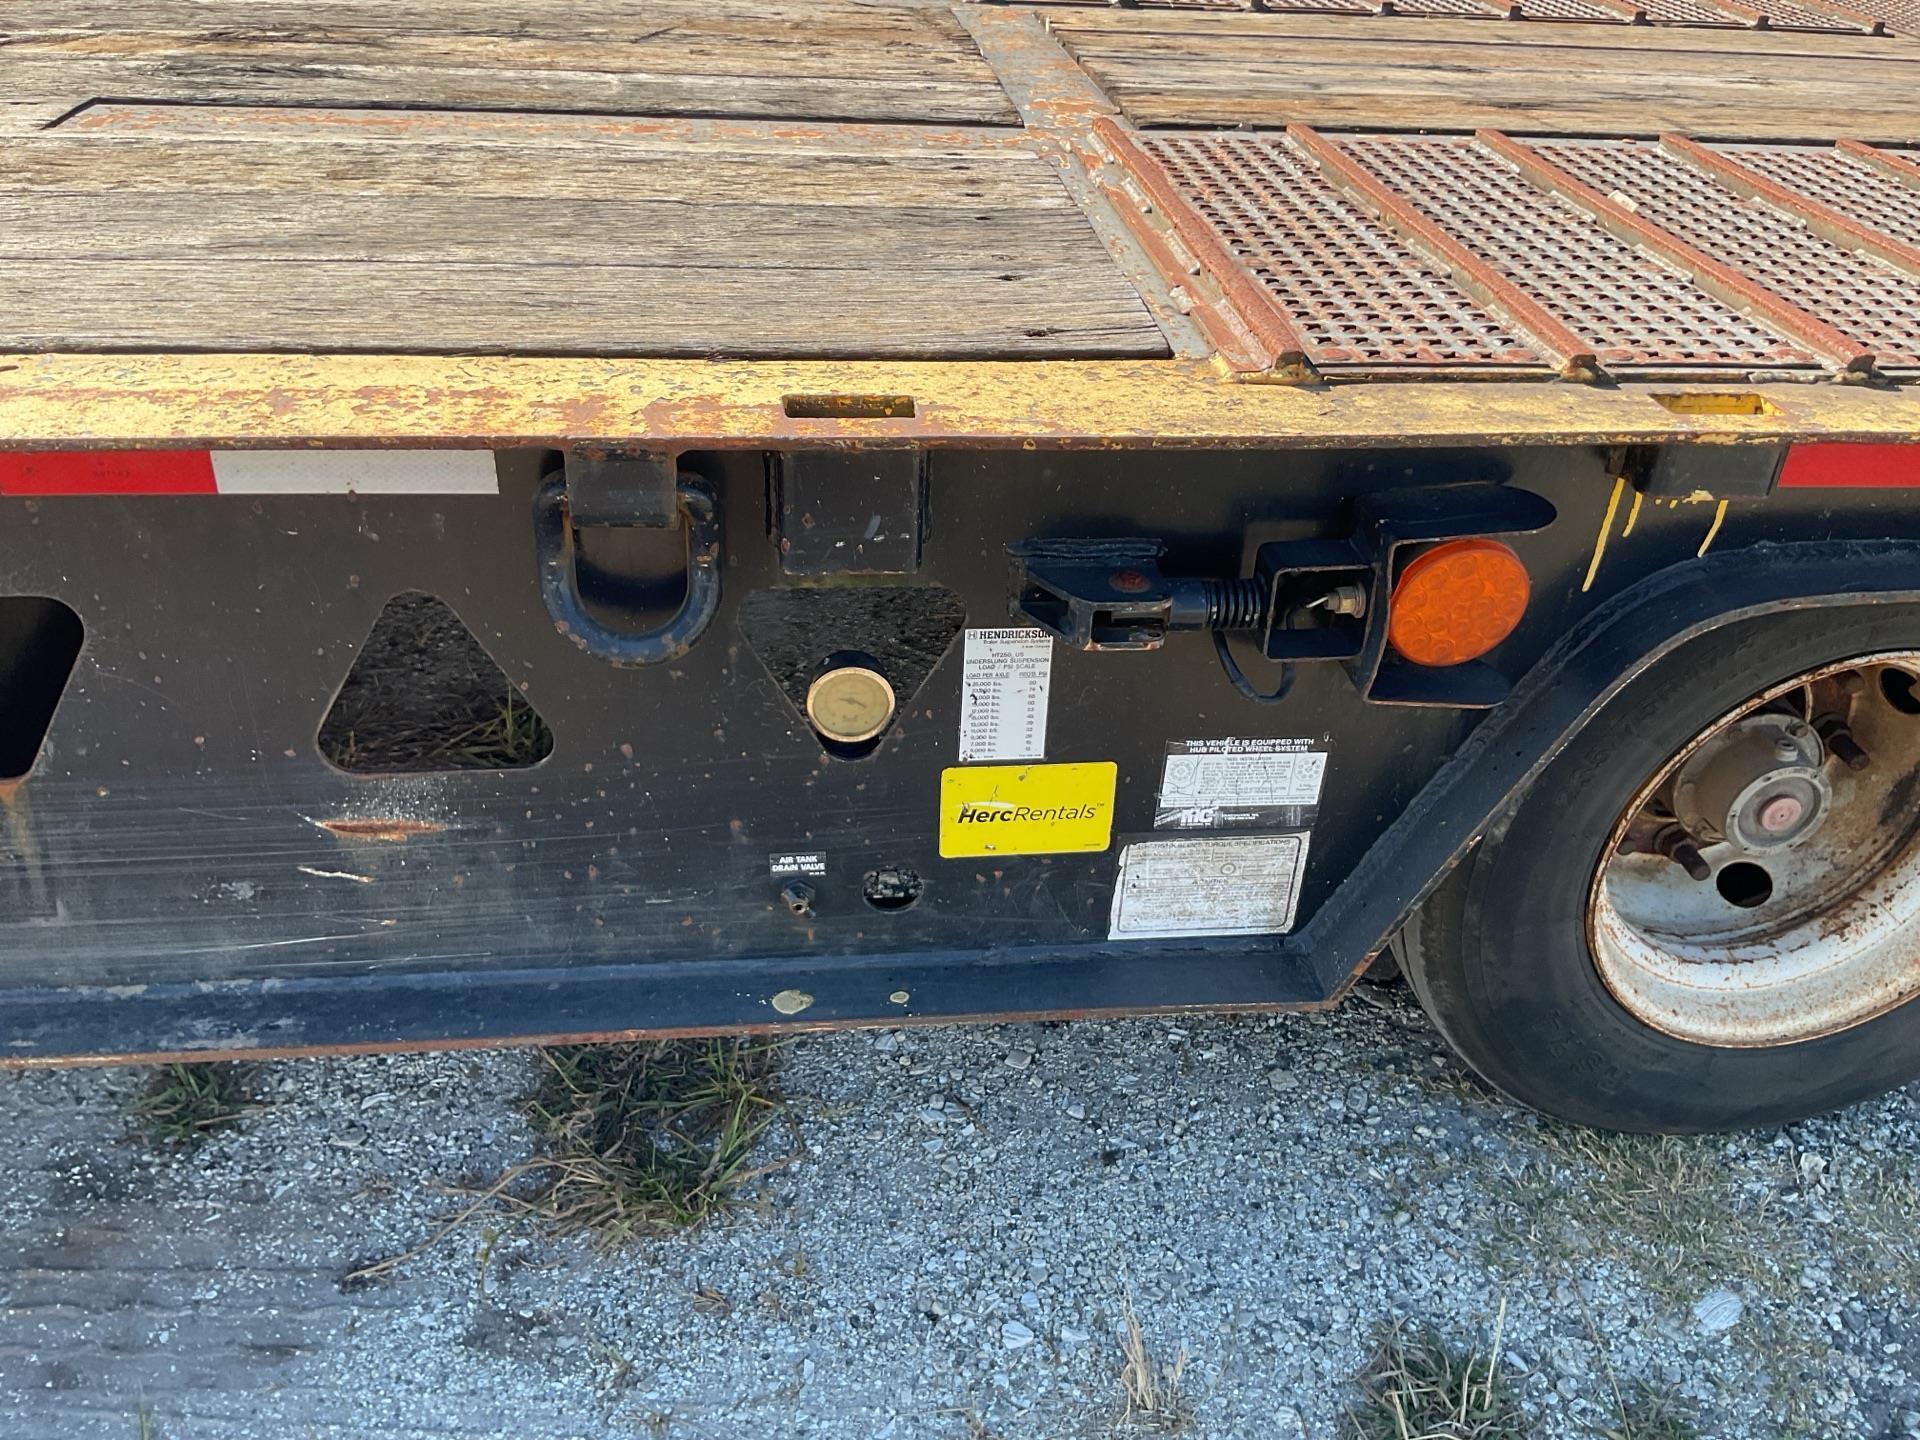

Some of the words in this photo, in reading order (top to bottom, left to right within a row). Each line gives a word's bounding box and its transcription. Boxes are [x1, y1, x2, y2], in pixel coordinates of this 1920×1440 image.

[979, 630, 1051, 640] HENDRICKSON
[779, 856, 794, 864] AIR
[796, 855, 818, 863] TANK
[772, 864, 799, 872] DRAIN
